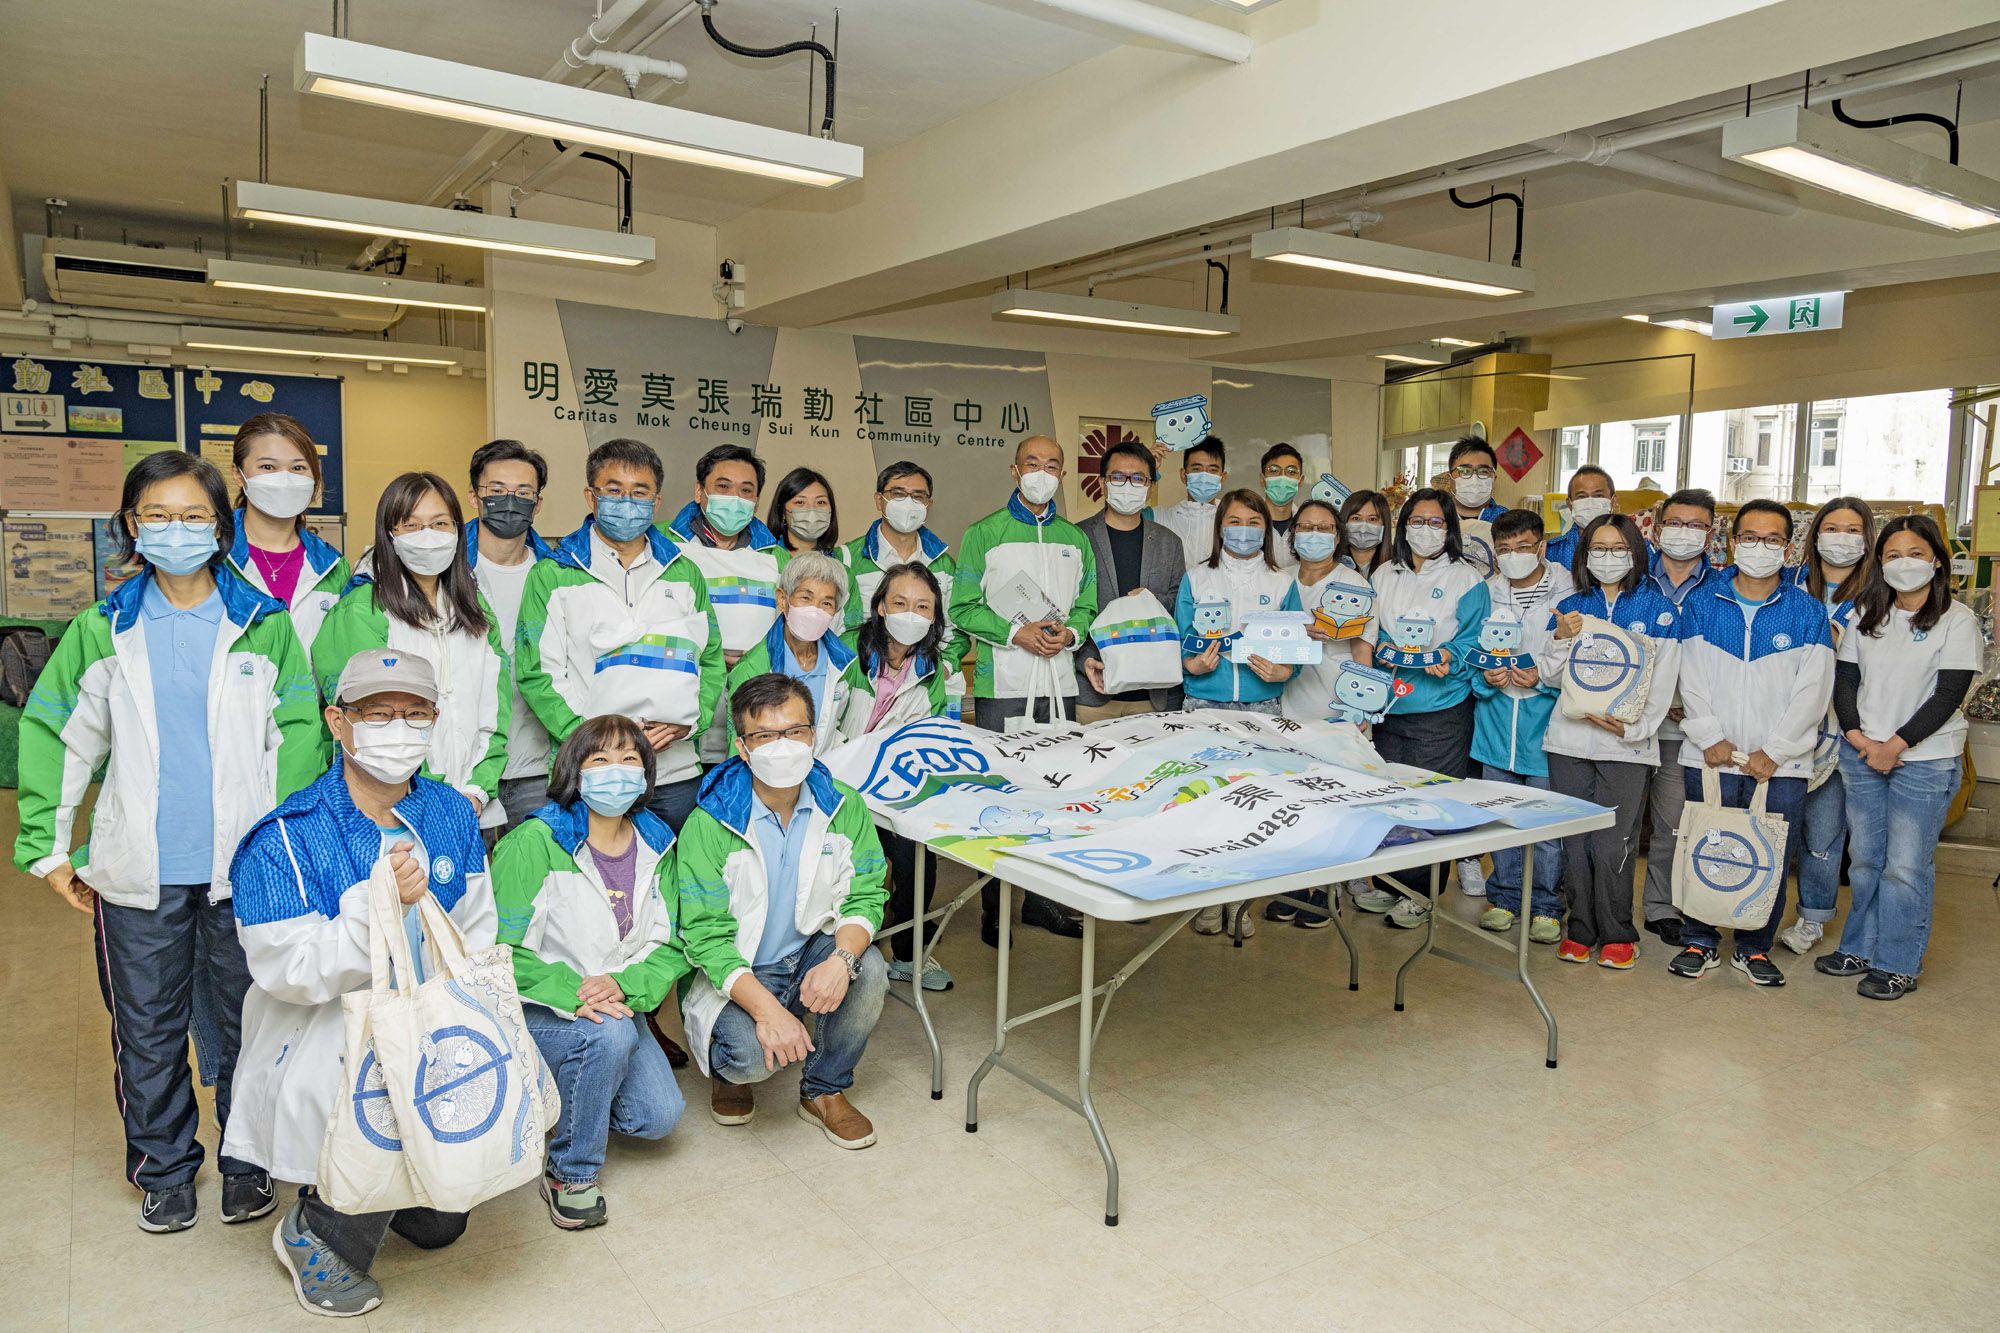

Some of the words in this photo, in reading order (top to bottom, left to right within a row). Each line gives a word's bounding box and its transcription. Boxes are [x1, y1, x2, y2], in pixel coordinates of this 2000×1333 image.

[12, 358, 275, 405] 勤社區中心
[524, 361, 1030, 434] 明愛莫張瑞勤社區中心
[553, 405, 618, 424] Caritas
[636, 412, 671, 428] Mok
[688, 416, 751, 436] Cheung
[768, 421, 794, 436] Sui
[810, 424, 840, 438] Kun
[856, 428, 941, 447] Community
[957, 434, 1005, 448] Centre
[1195, 636, 1232, 649] DD
[1382, 648, 1435, 665] 渠務署
[1478, 655, 1519, 667] DSD
[868, 747, 990, 801] CEDD
[1219, 775, 1347, 812] 渠務
[1175, 799, 1306, 858] Drainage
[1300, 782, 1408, 806] Services
